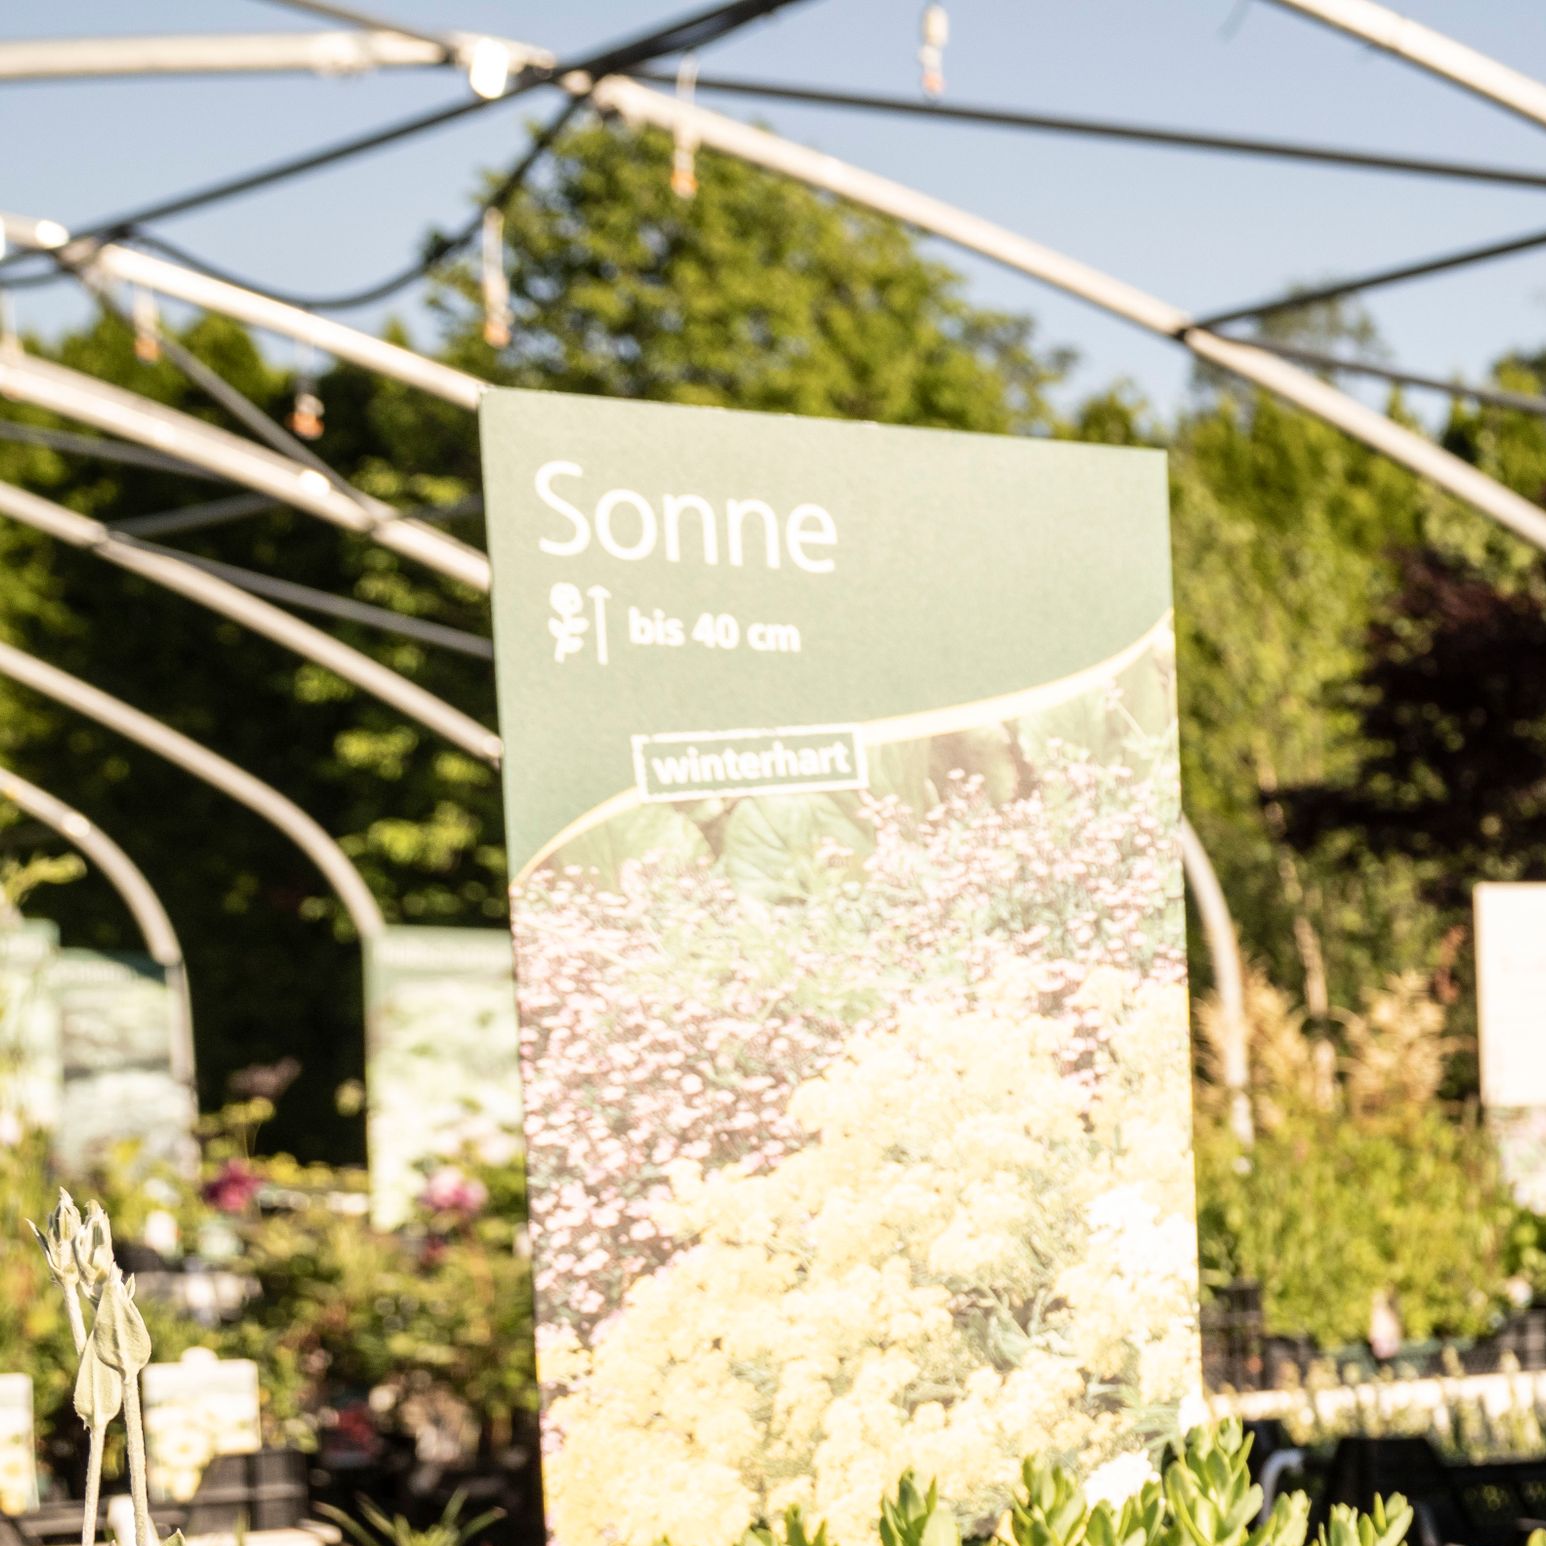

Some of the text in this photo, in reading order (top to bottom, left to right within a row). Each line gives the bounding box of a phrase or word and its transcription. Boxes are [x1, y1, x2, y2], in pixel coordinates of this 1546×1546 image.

[533, 459, 839, 574] Sonne
[629, 607, 802, 653] bis 40 cm
[650, 740, 852, 786] winterhart
